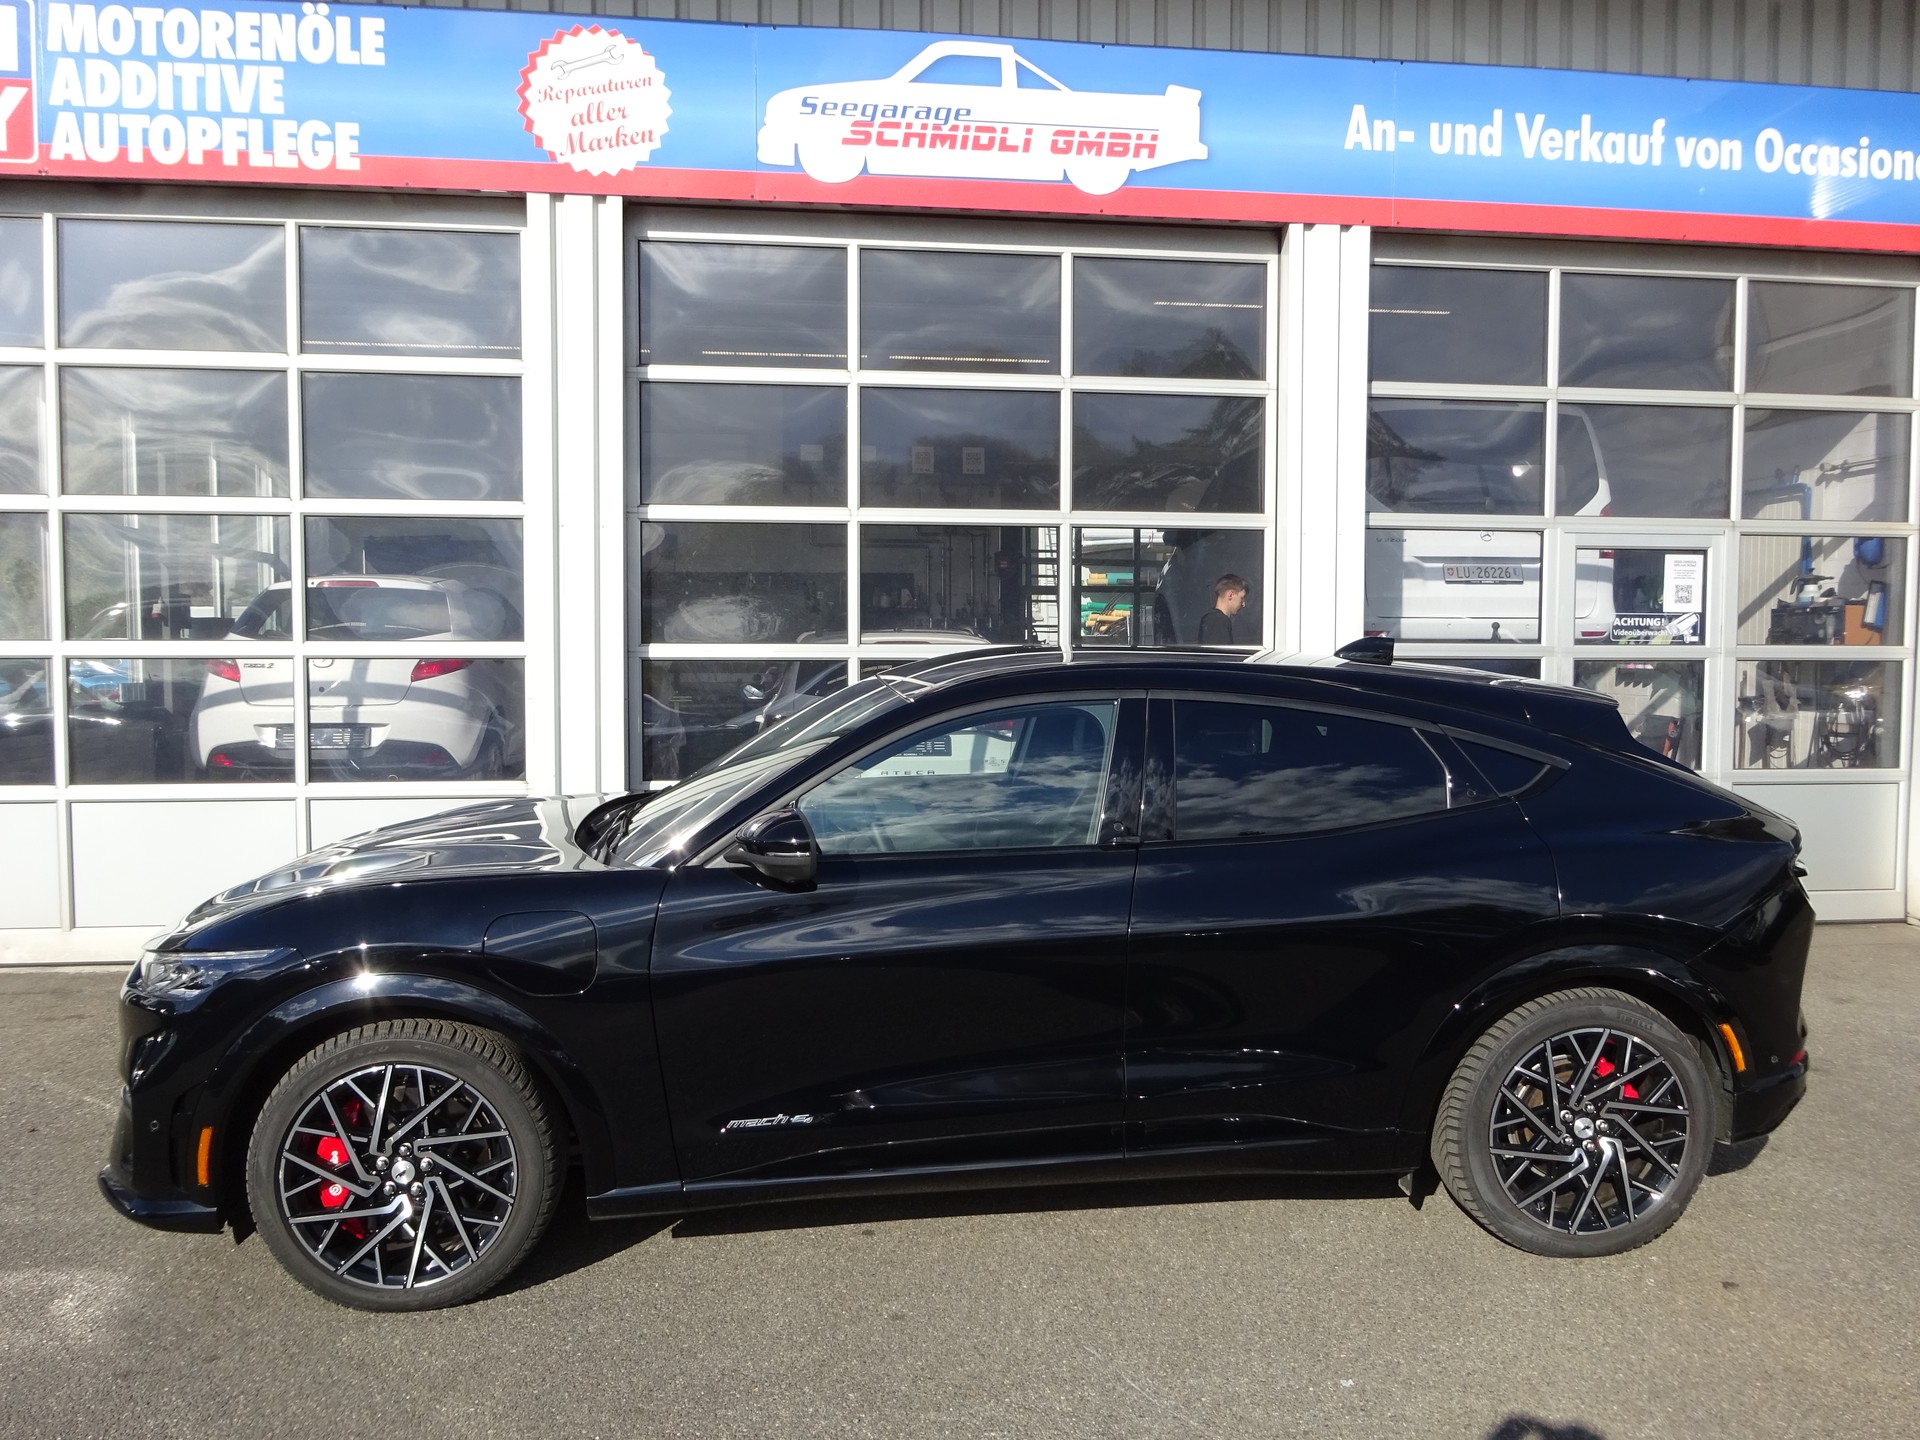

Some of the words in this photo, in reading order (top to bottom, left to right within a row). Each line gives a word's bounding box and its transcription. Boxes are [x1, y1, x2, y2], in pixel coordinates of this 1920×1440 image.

[46, 2, 386, 66] MOTORENÖLE
[48, 57, 285, 114] ADDITIVE
[538, 77, 652, 104] Reparaturen
[571, 101, 628, 127] aller
[800, 96, 972, 125] Seegarage
[49, 111, 362, 171] AUTOPFLEGE
[558, 125, 655, 156] Marken
[841, 121, 1033, 154] SCHMIDLI
[1050, 129, 1159, 160] GMBH
[1344, 104, 1415, 152] An-
[1429, 109, 1503, 157] und
[1515, 112, 1665, 165] Verkauf
[1676, 135, 1742, 170] von
[1613, 618, 1665, 627] ACHTUNG!
